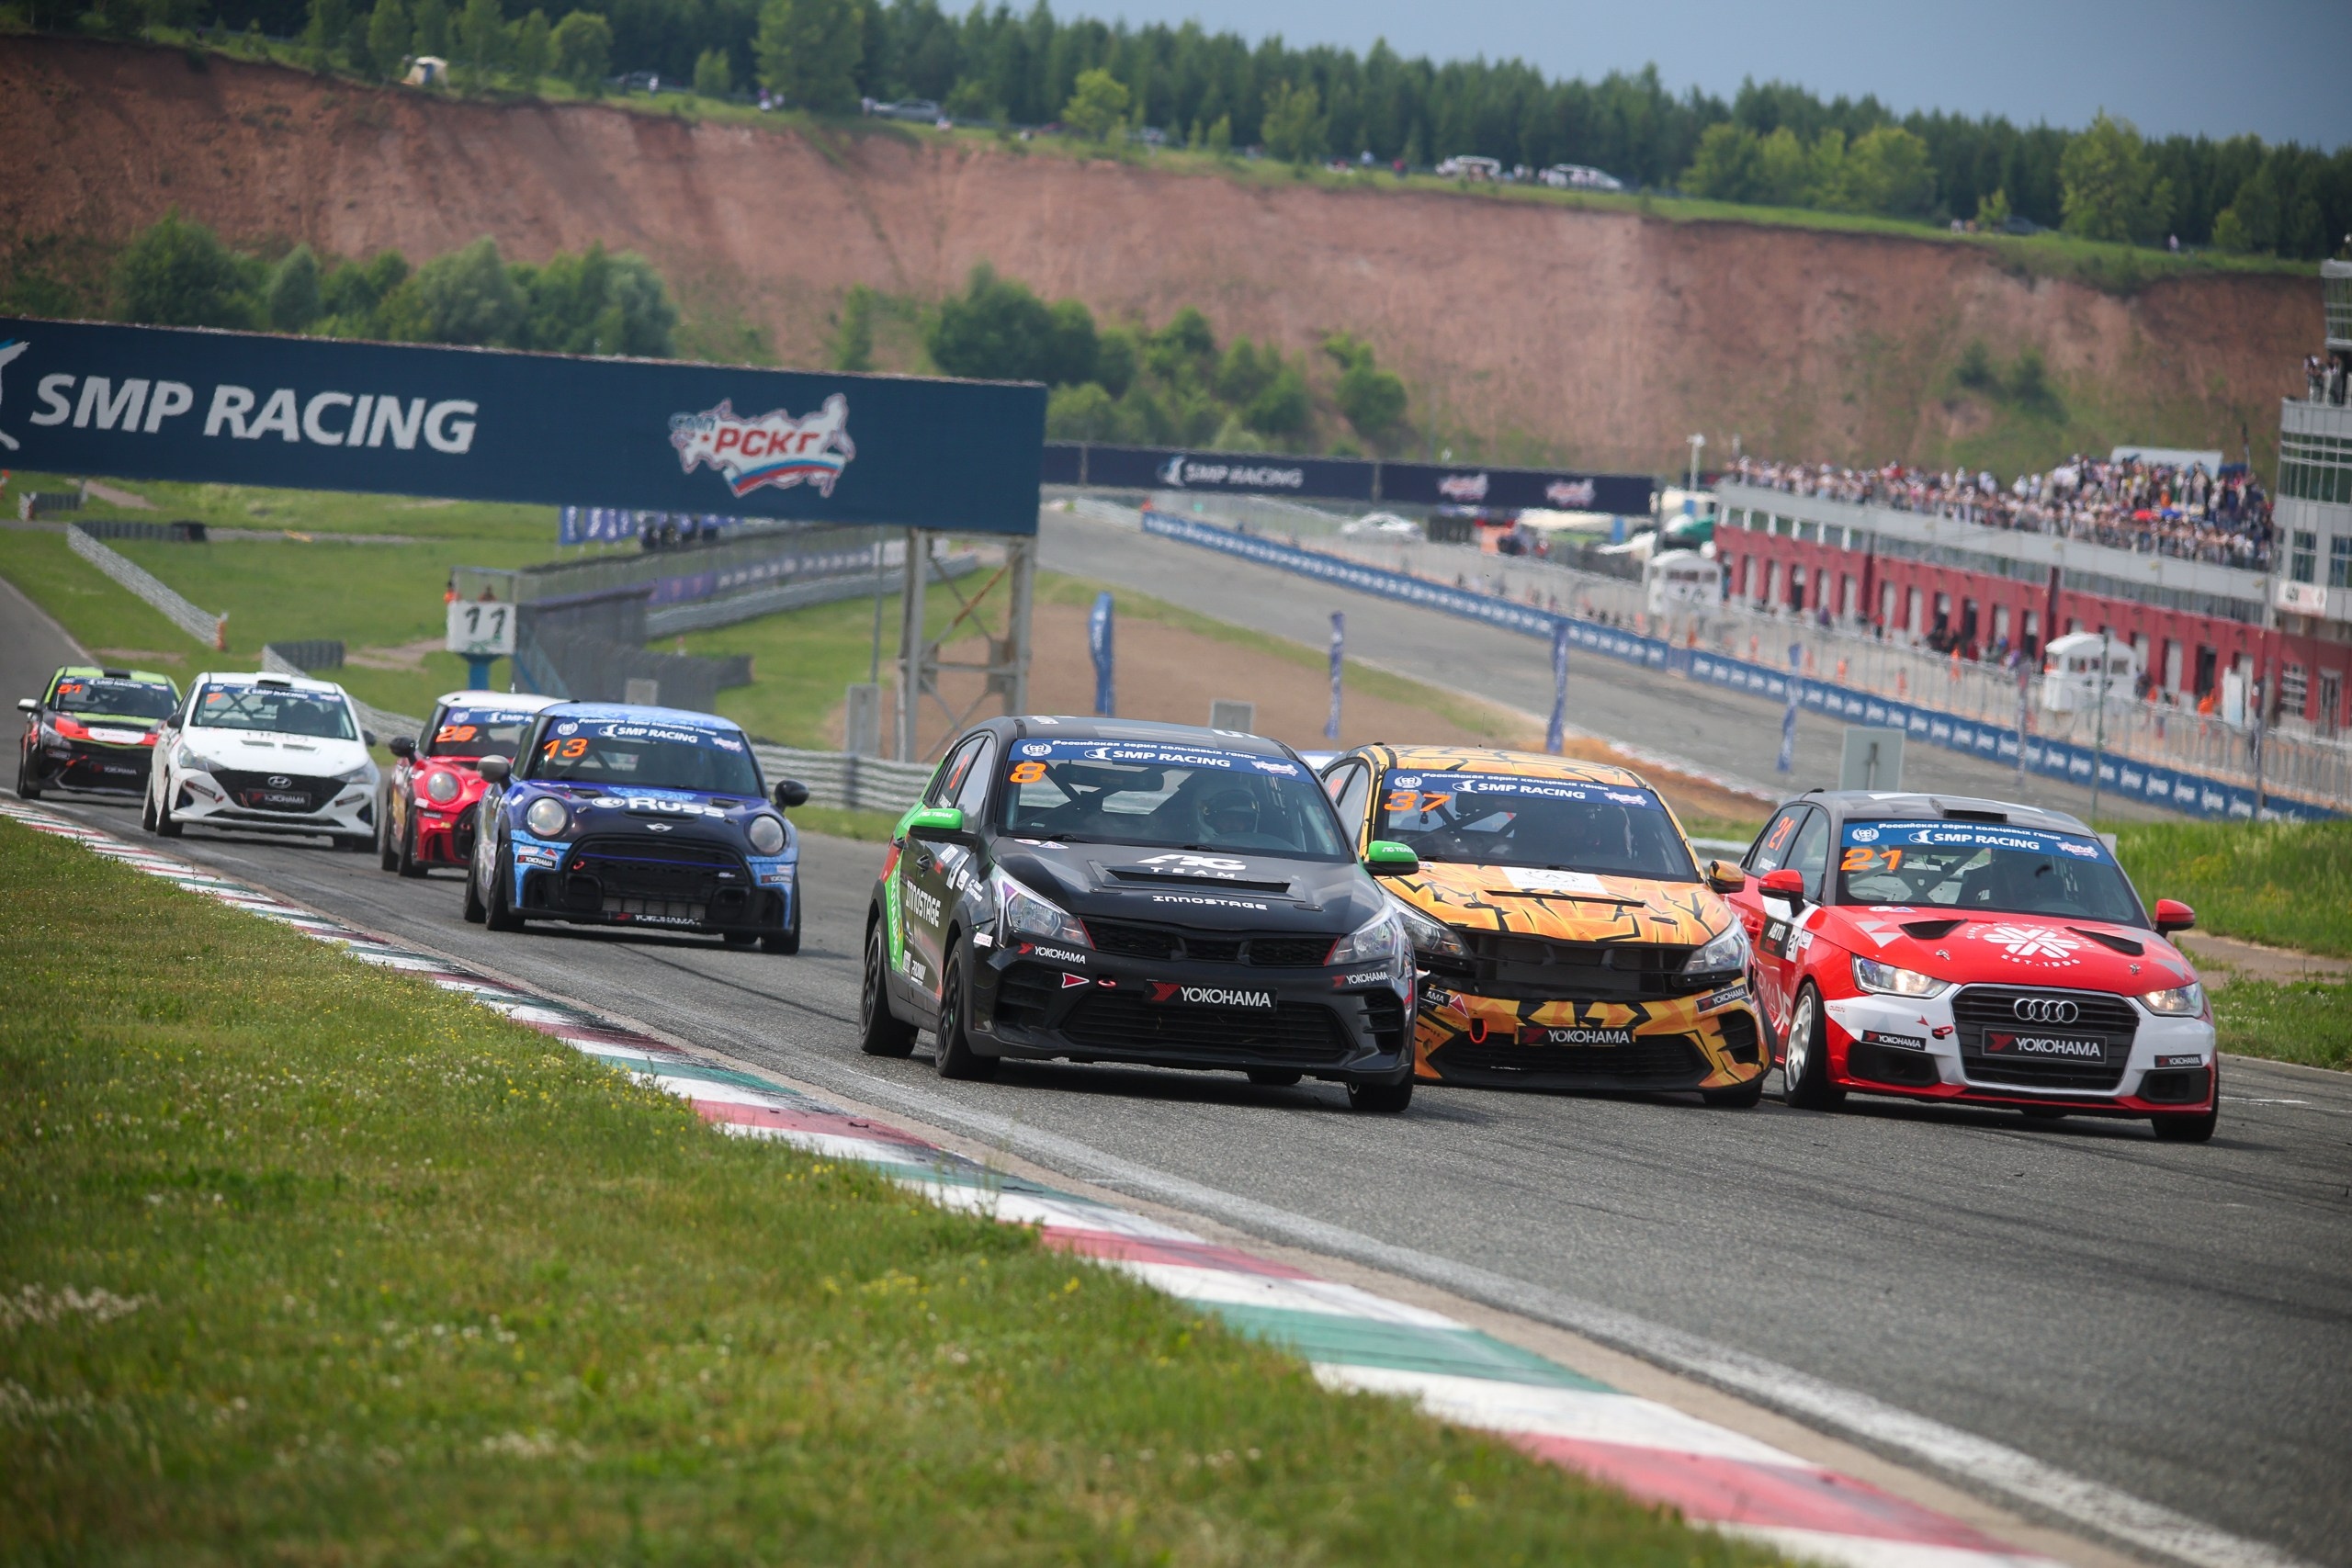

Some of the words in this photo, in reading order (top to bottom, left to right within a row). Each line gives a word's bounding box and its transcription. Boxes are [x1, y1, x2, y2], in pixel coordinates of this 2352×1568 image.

[29, 373, 193, 433] SMP
[203, 384, 479, 454] RACING
[713, 426, 820, 457] РСКГ
[465, 606, 505, 639] 11
[58, 683, 83, 694] 51
[435, 725, 478, 743] 28
[616, 726, 648, 737] SMP
[648, 728, 699, 744] RACING
[543, 738, 589, 760] 13
[1160, 745, 1223, 755] кольцевых
[1225, 751, 1257, 760] гонок
[1112, 750, 1156, 761] SMP
[1158, 753, 1231, 768] RACING
[1009, 761, 1047, 784] 8
[1477, 783, 1518, 793] SMP
[1520, 785, 1586, 799] RACING
[1487, 774, 1519, 783] серия
[1521, 777, 1577, 787] кольцевых
[1579, 783, 1609, 791] гонок
[1383, 791, 1452, 813] 37
[1768, 816, 1796, 852] 21
[1933, 832, 1973, 843] SMP
[1975, 834, 2040, 851] RACING
[1975, 826, 2031, 836] кольцевых
[2032, 831, 2062, 840] гонок
[1839, 847, 1903, 872] 21
[1151, 866, 1236, 879] TEAM
[905, 879, 942, 929] INNOSTAGE
[1152, 895, 1268, 911] INNOSTAGE
[1767, 921, 1787, 942] АВТО
[1787, 934, 1800, 953] 21
[1035, 945, 1086, 964] YOKOHAMA
[1346, 971, 1389, 986] YOKOHAMA
[1181, 986, 1272, 1008] YOKOHAMA
[1712, 987, 1746, 1005] YOKOHAMA
[1548, 1029, 1631, 1043] YOKOHAMA
[1879, 1034, 1921, 1048] YOKOHAMA
[2016, 1037, 2101, 1056] YOKOHAMA
[2168, 1056, 2200, 1065] YOKOHAMA
